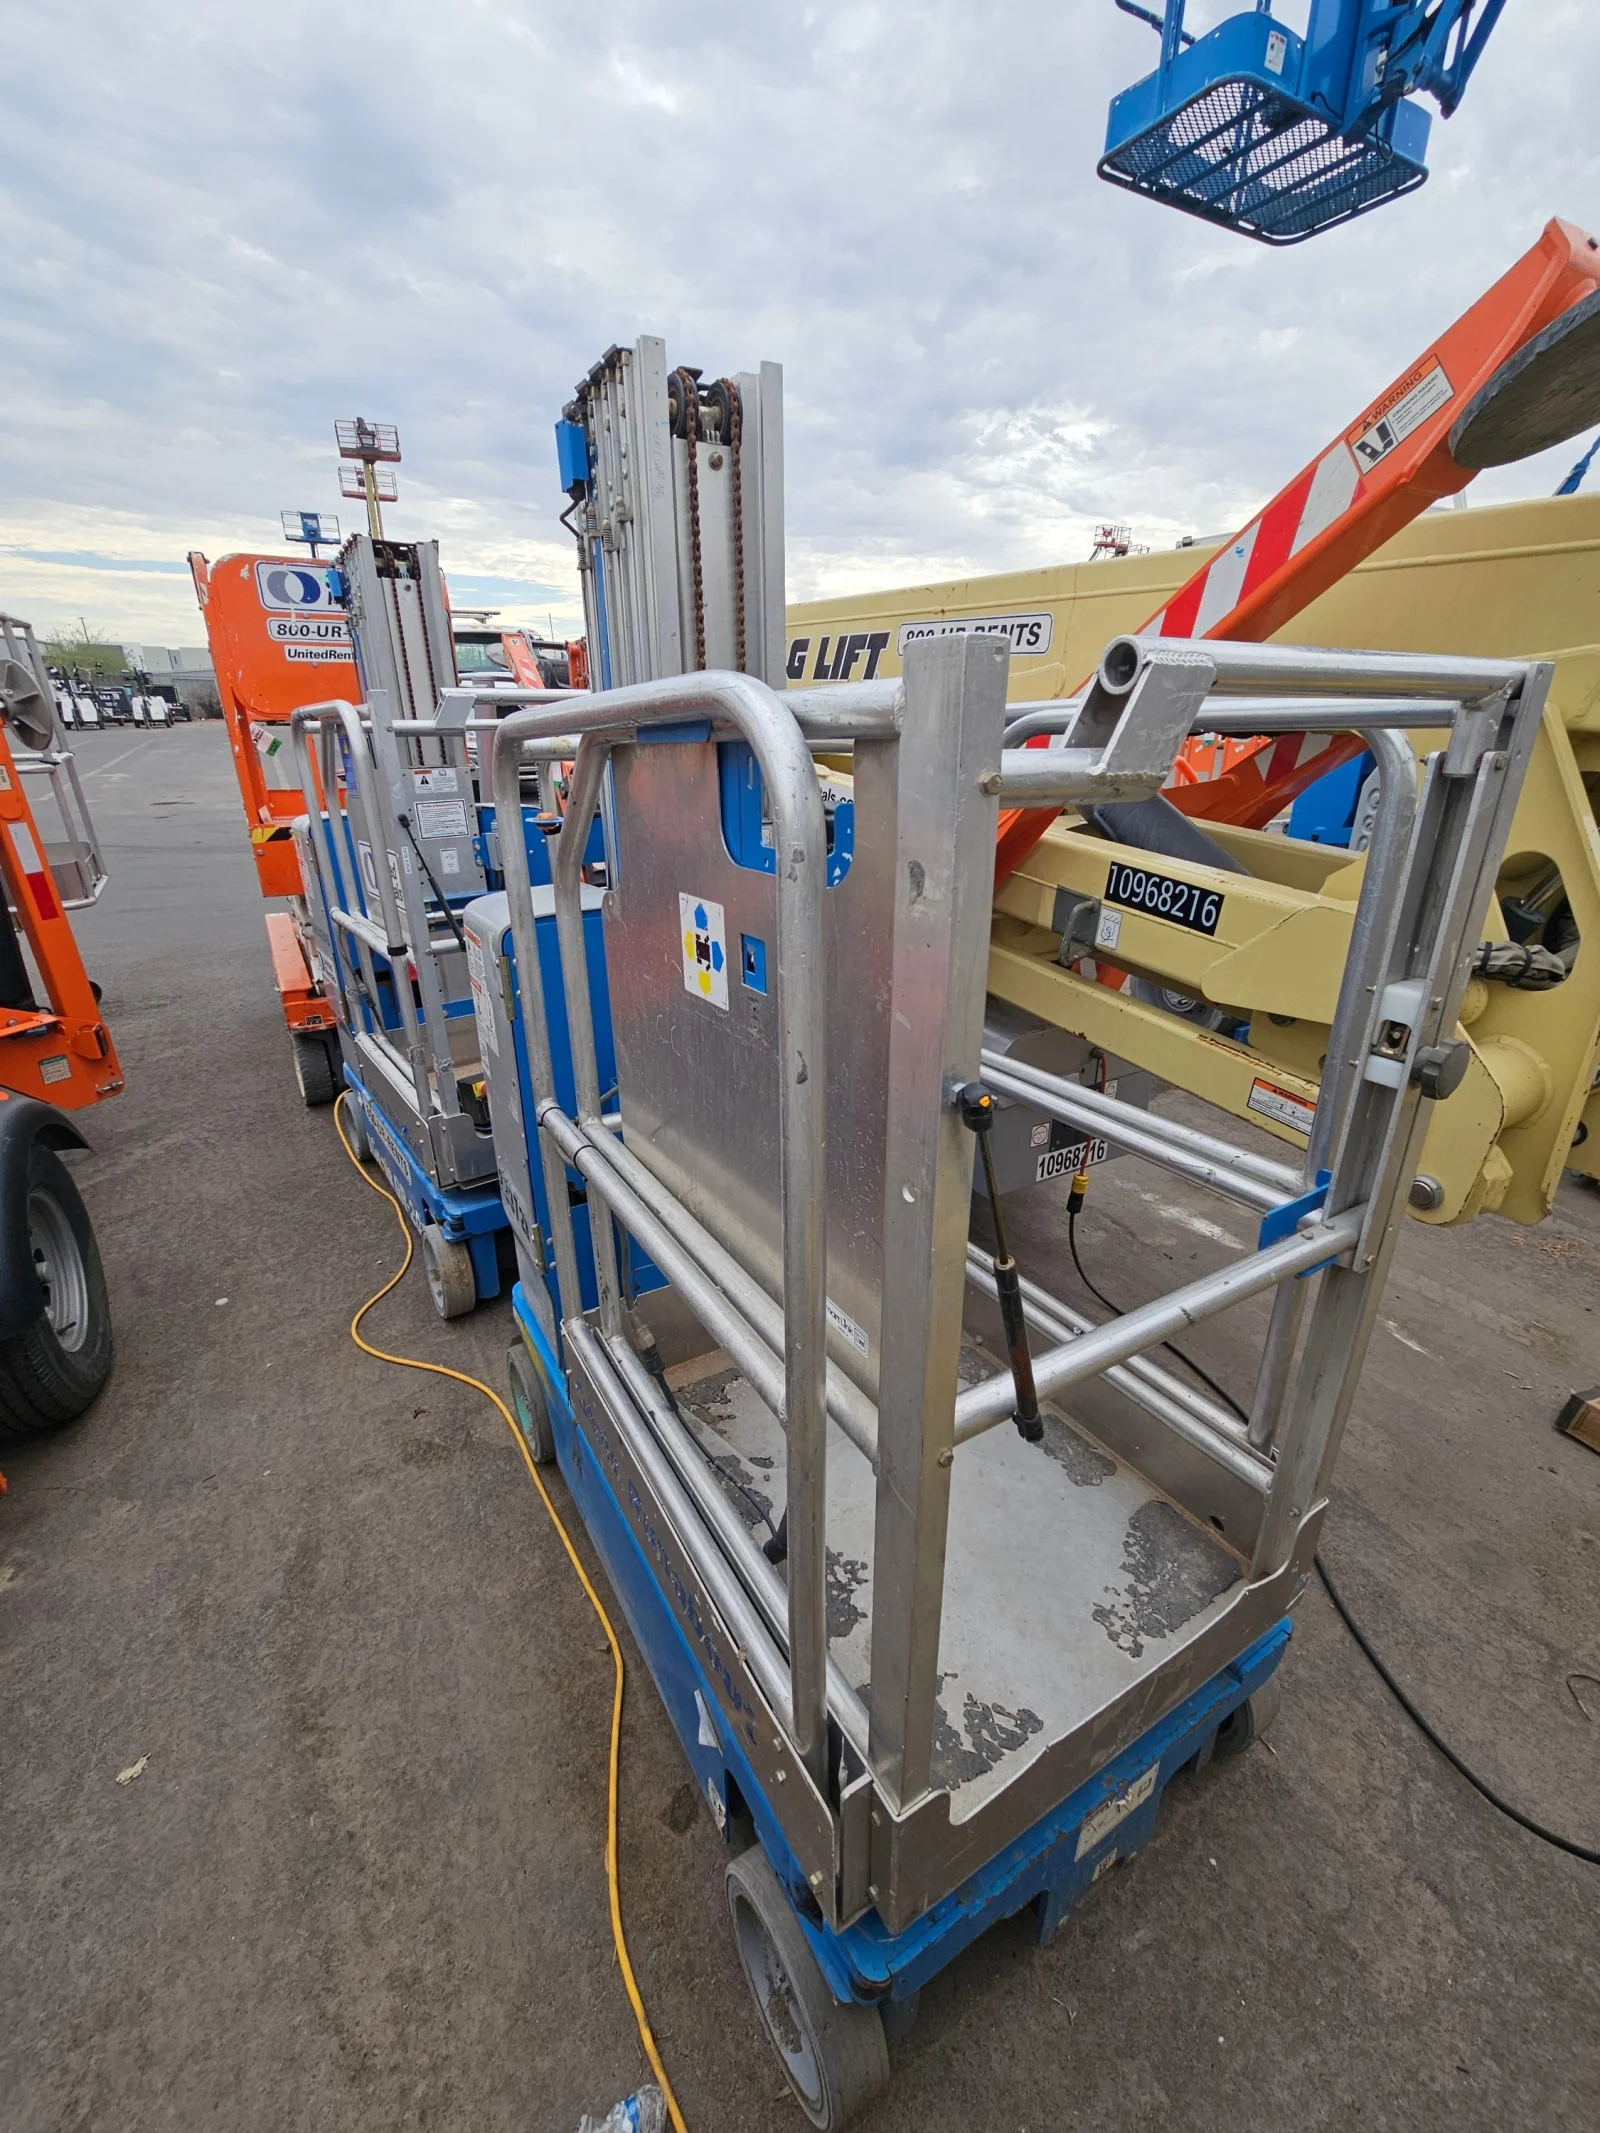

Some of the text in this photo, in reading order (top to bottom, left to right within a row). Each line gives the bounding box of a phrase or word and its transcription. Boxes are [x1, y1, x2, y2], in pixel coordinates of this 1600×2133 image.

[1372, 371, 1422, 420] WARNING
[813, 632, 890, 680] LIFT
[1109, 865, 1219, 927] 10968216
[1279, 1091, 1308, 1107] WARNING
